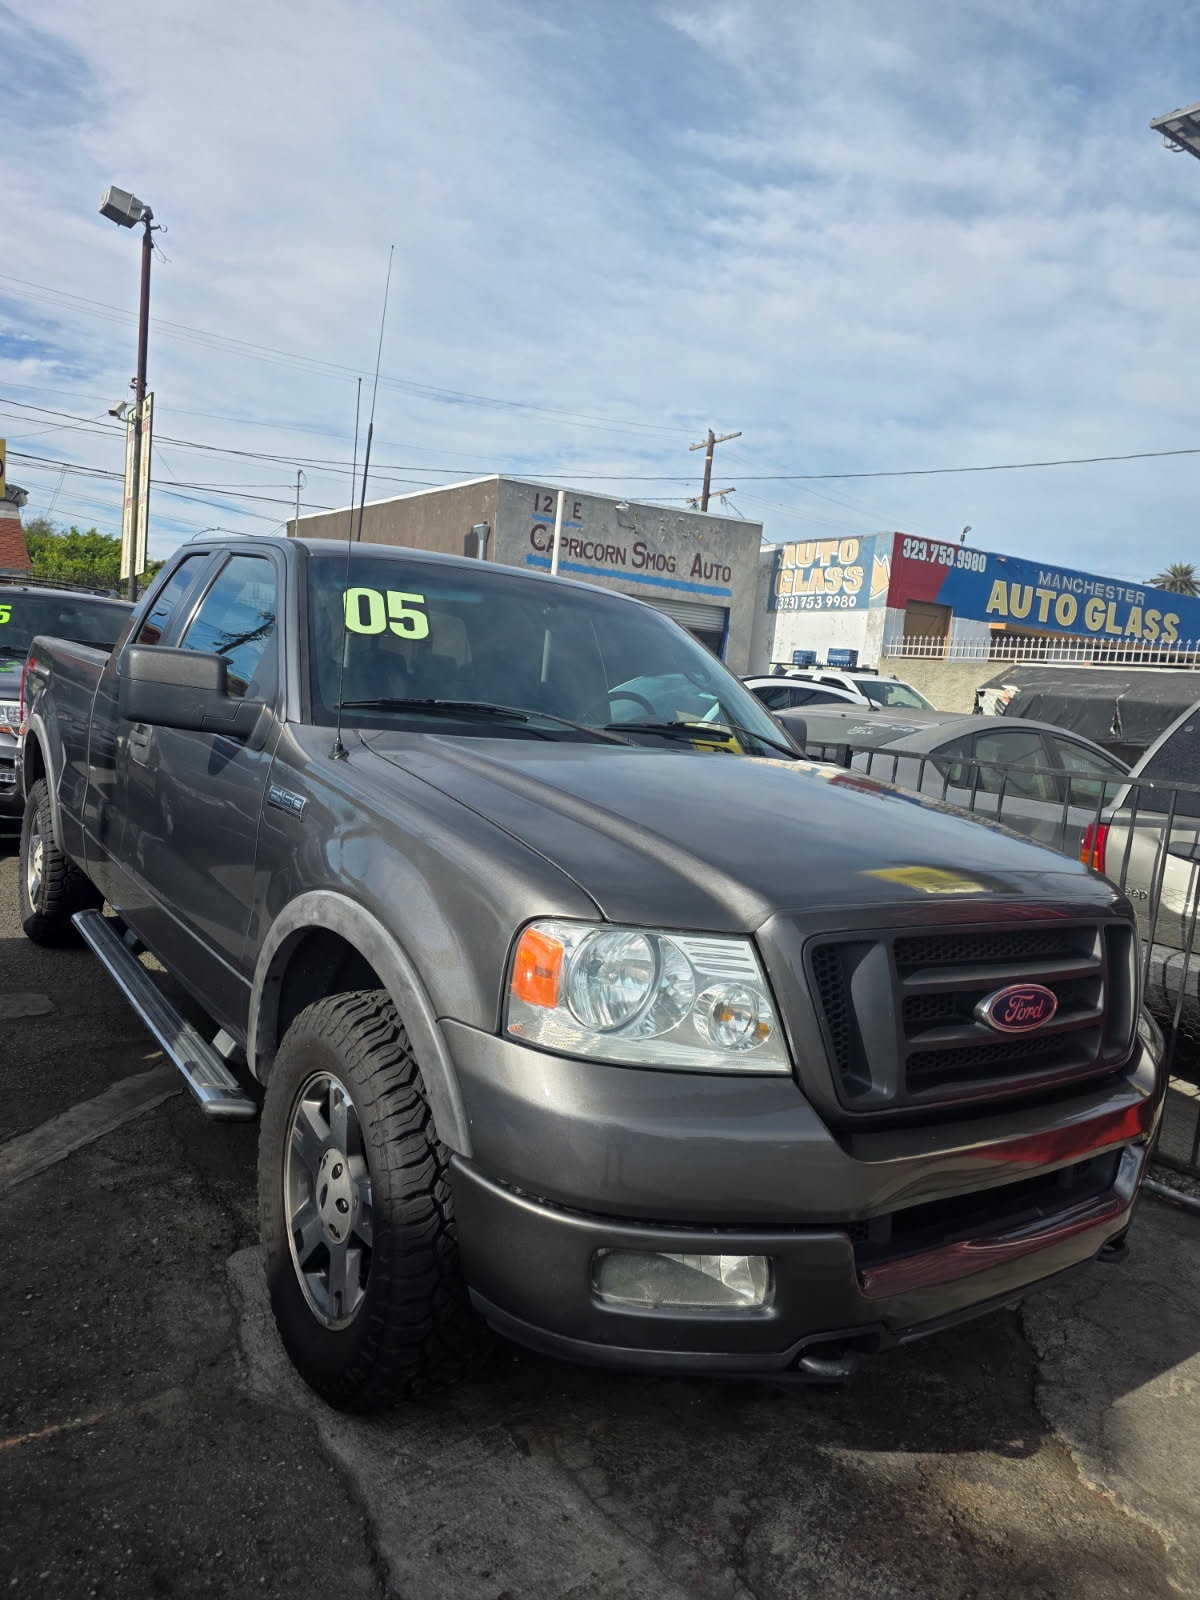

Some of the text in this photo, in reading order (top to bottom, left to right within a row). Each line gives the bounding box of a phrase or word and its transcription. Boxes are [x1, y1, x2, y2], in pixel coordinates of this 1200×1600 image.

[573, 502, 582, 519] E
[690, 552, 732, 583] AUTO
[779, 538, 860, 569] AUTO
[903, 538, 987, 573] 323.753.9980
[775, 566, 864, 597] GLASS
[1038, 570, 1145, 606] MANCHESTER
[343, 587, 430, 640] 05
[986, 579, 1180, 644] AUTO GLASS
[1004, 994, 1044, 1022] Ford
